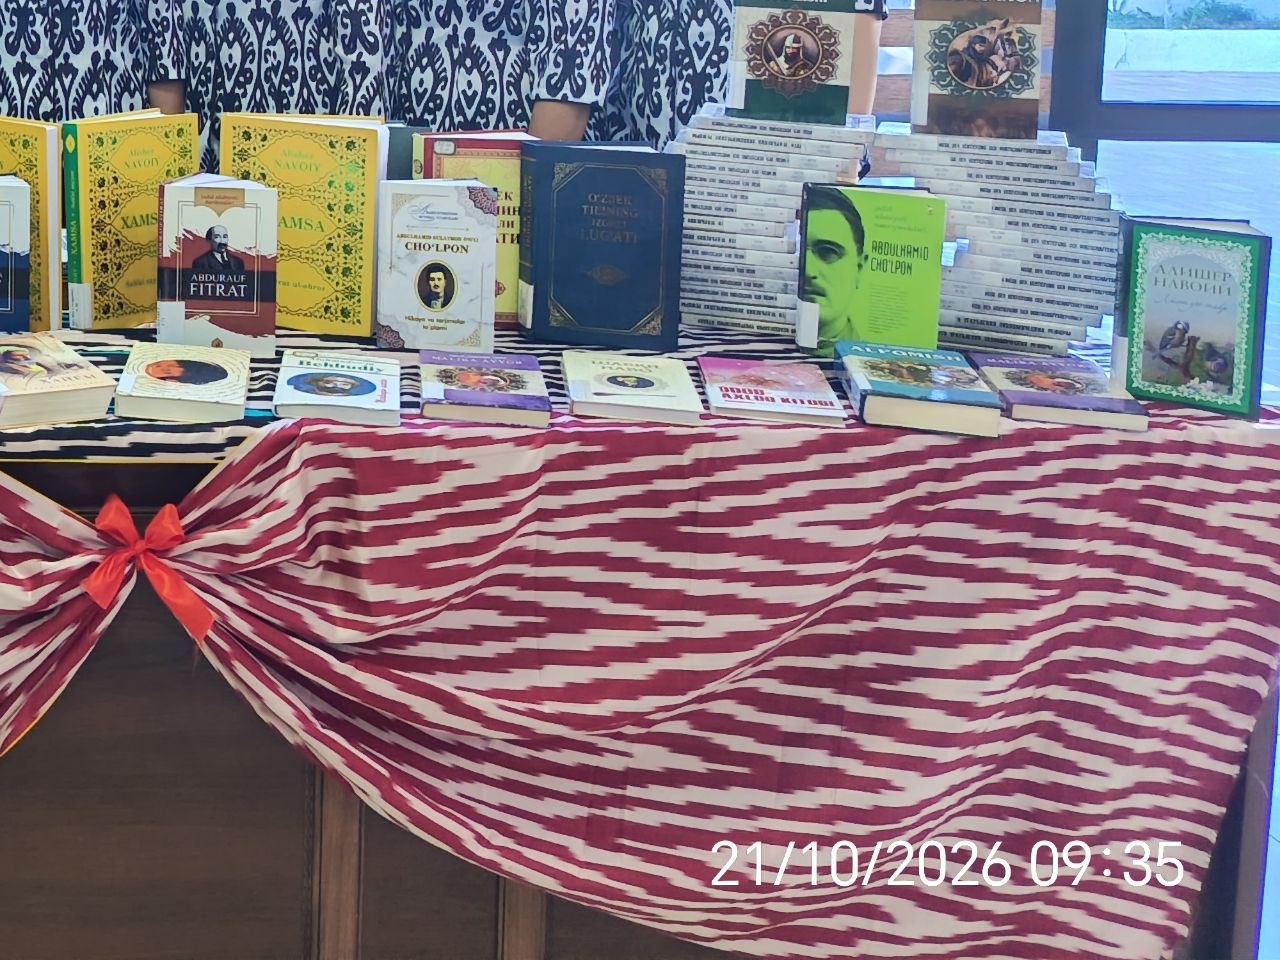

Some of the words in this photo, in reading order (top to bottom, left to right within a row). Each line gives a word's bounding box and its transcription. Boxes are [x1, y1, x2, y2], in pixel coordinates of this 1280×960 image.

[124, 157, 161, 170] NAVOIY
[274, 159, 321, 173] NAVOIY
[121, 212, 158, 230] XAMS
[278, 215, 326, 233] AMSA
[871, 240, 929, 261] ABDULHAMID
[191, 272, 248, 283] ABDURAUF
[1154, 264, 1233, 283] АЛИШЕР
[190, 283, 248, 297] FITRAT
[850, 344, 962, 363] ALPOMISH
[780, 396, 835, 407] KITOBI
